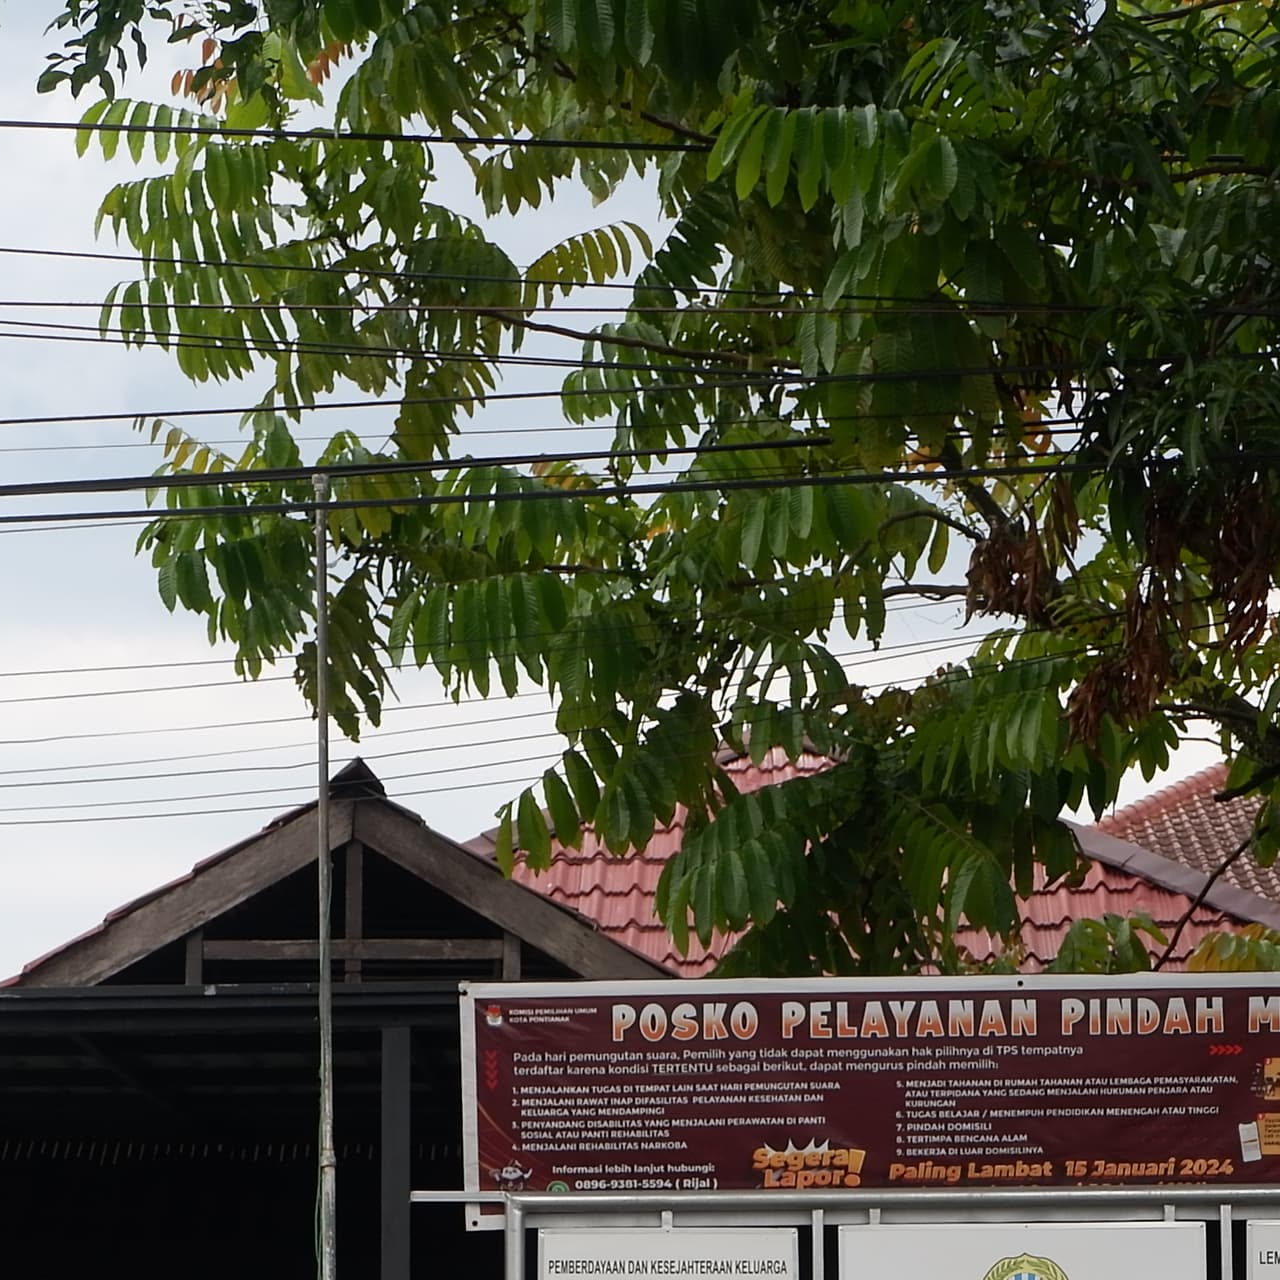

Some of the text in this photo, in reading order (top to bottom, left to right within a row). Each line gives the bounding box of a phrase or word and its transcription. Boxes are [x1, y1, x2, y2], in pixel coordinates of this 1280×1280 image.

[612, 1001, 758, 1042] POSKO
[781, 998, 1037, 1039] PELAYANAN
[1061, 996, 1224, 1035] PINDAH
[513, 1045, 1083, 1064] Pada hari pemungutan suara, Pemilih yang tidak dapat menggunakan hak pilihnya di TPS tempatnya
[552, 1162, 714, 1174] Informasi lebih lanjut hubungi:
[752, 1147, 850, 1171] Segera
[888, 1157, 1234, 1182] Paling Lambat 15 Januari 2024
[548, 1259, 787, 1274] PEMBERDAYAAN DAN KESEJAHTERAAN KELUARGA
